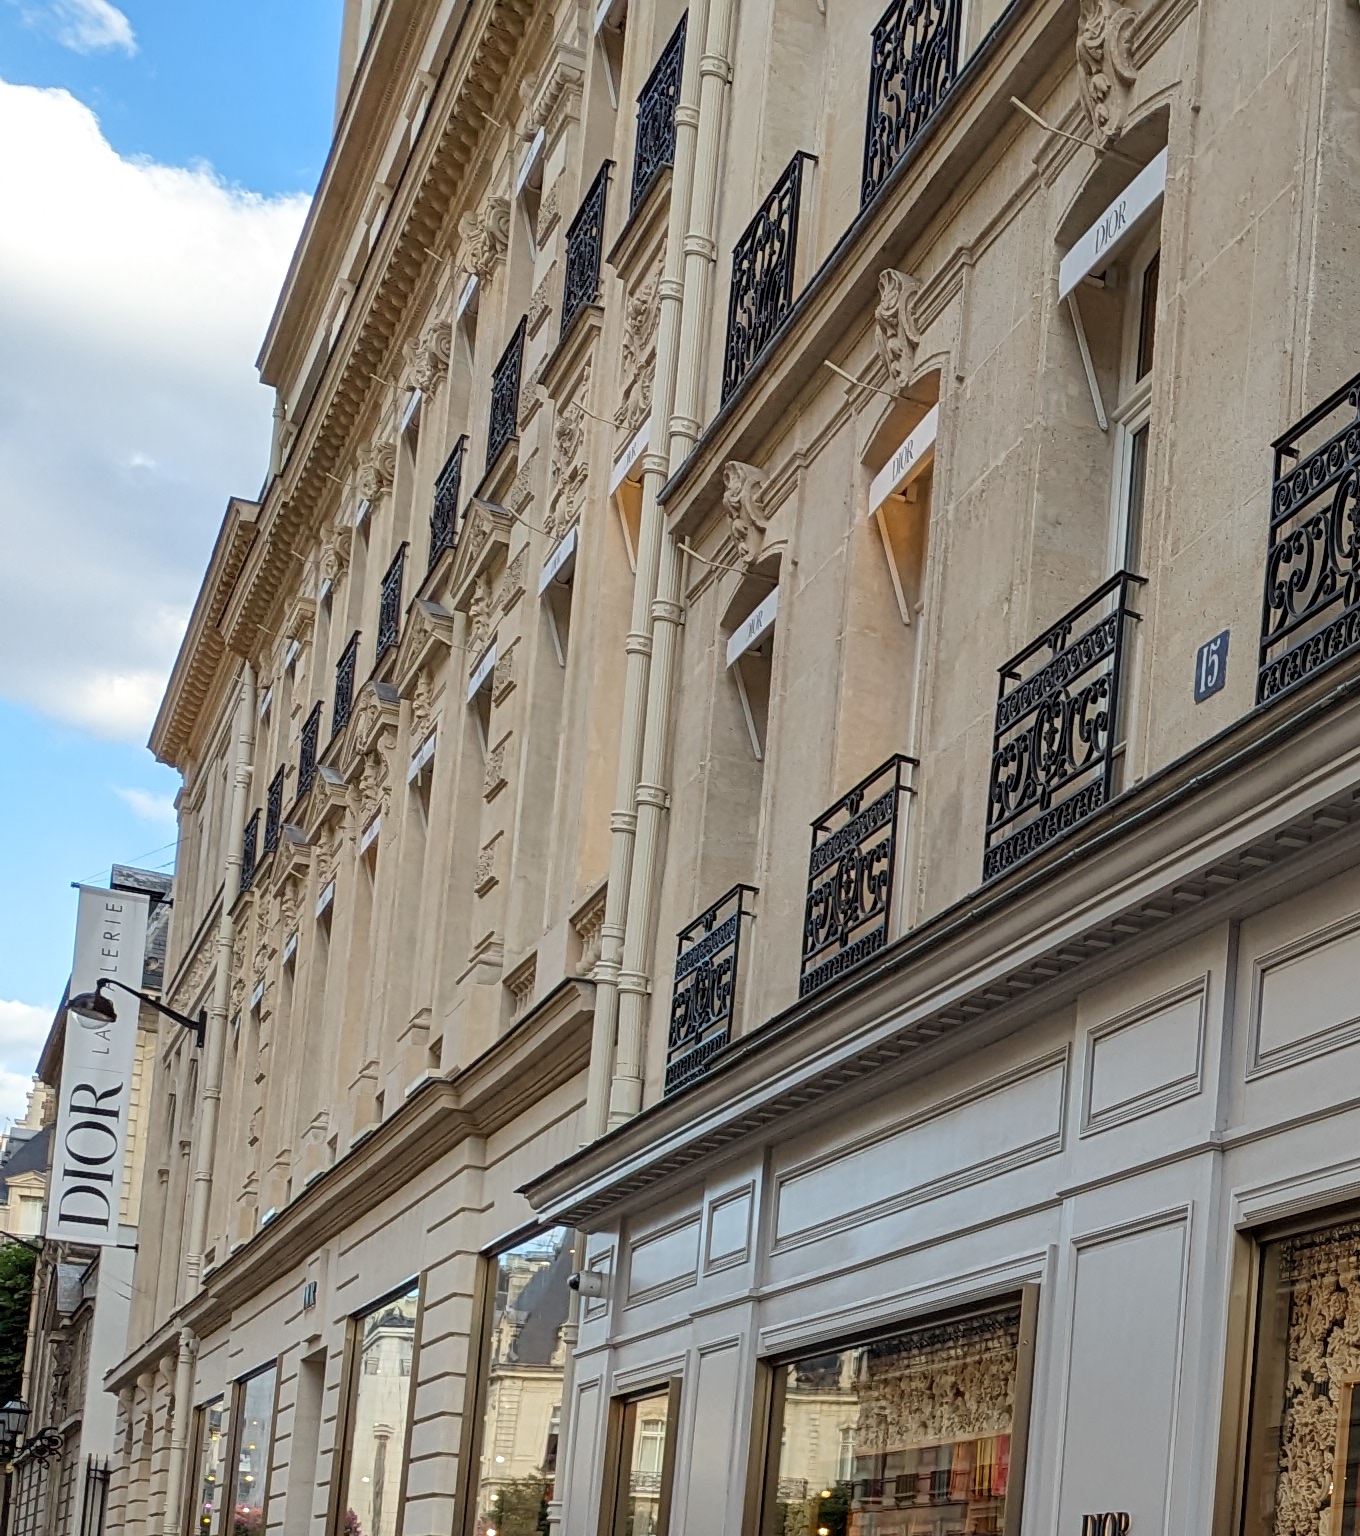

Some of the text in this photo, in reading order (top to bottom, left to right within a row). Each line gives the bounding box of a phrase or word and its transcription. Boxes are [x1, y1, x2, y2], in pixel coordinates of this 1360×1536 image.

[1095, 200, 1126, 255] DIOR
[1199, 637, 1221, 693] 15
[92, 902, 123, 1055] LA LERIE
[58, 1082, 124, 1232] DIOR
